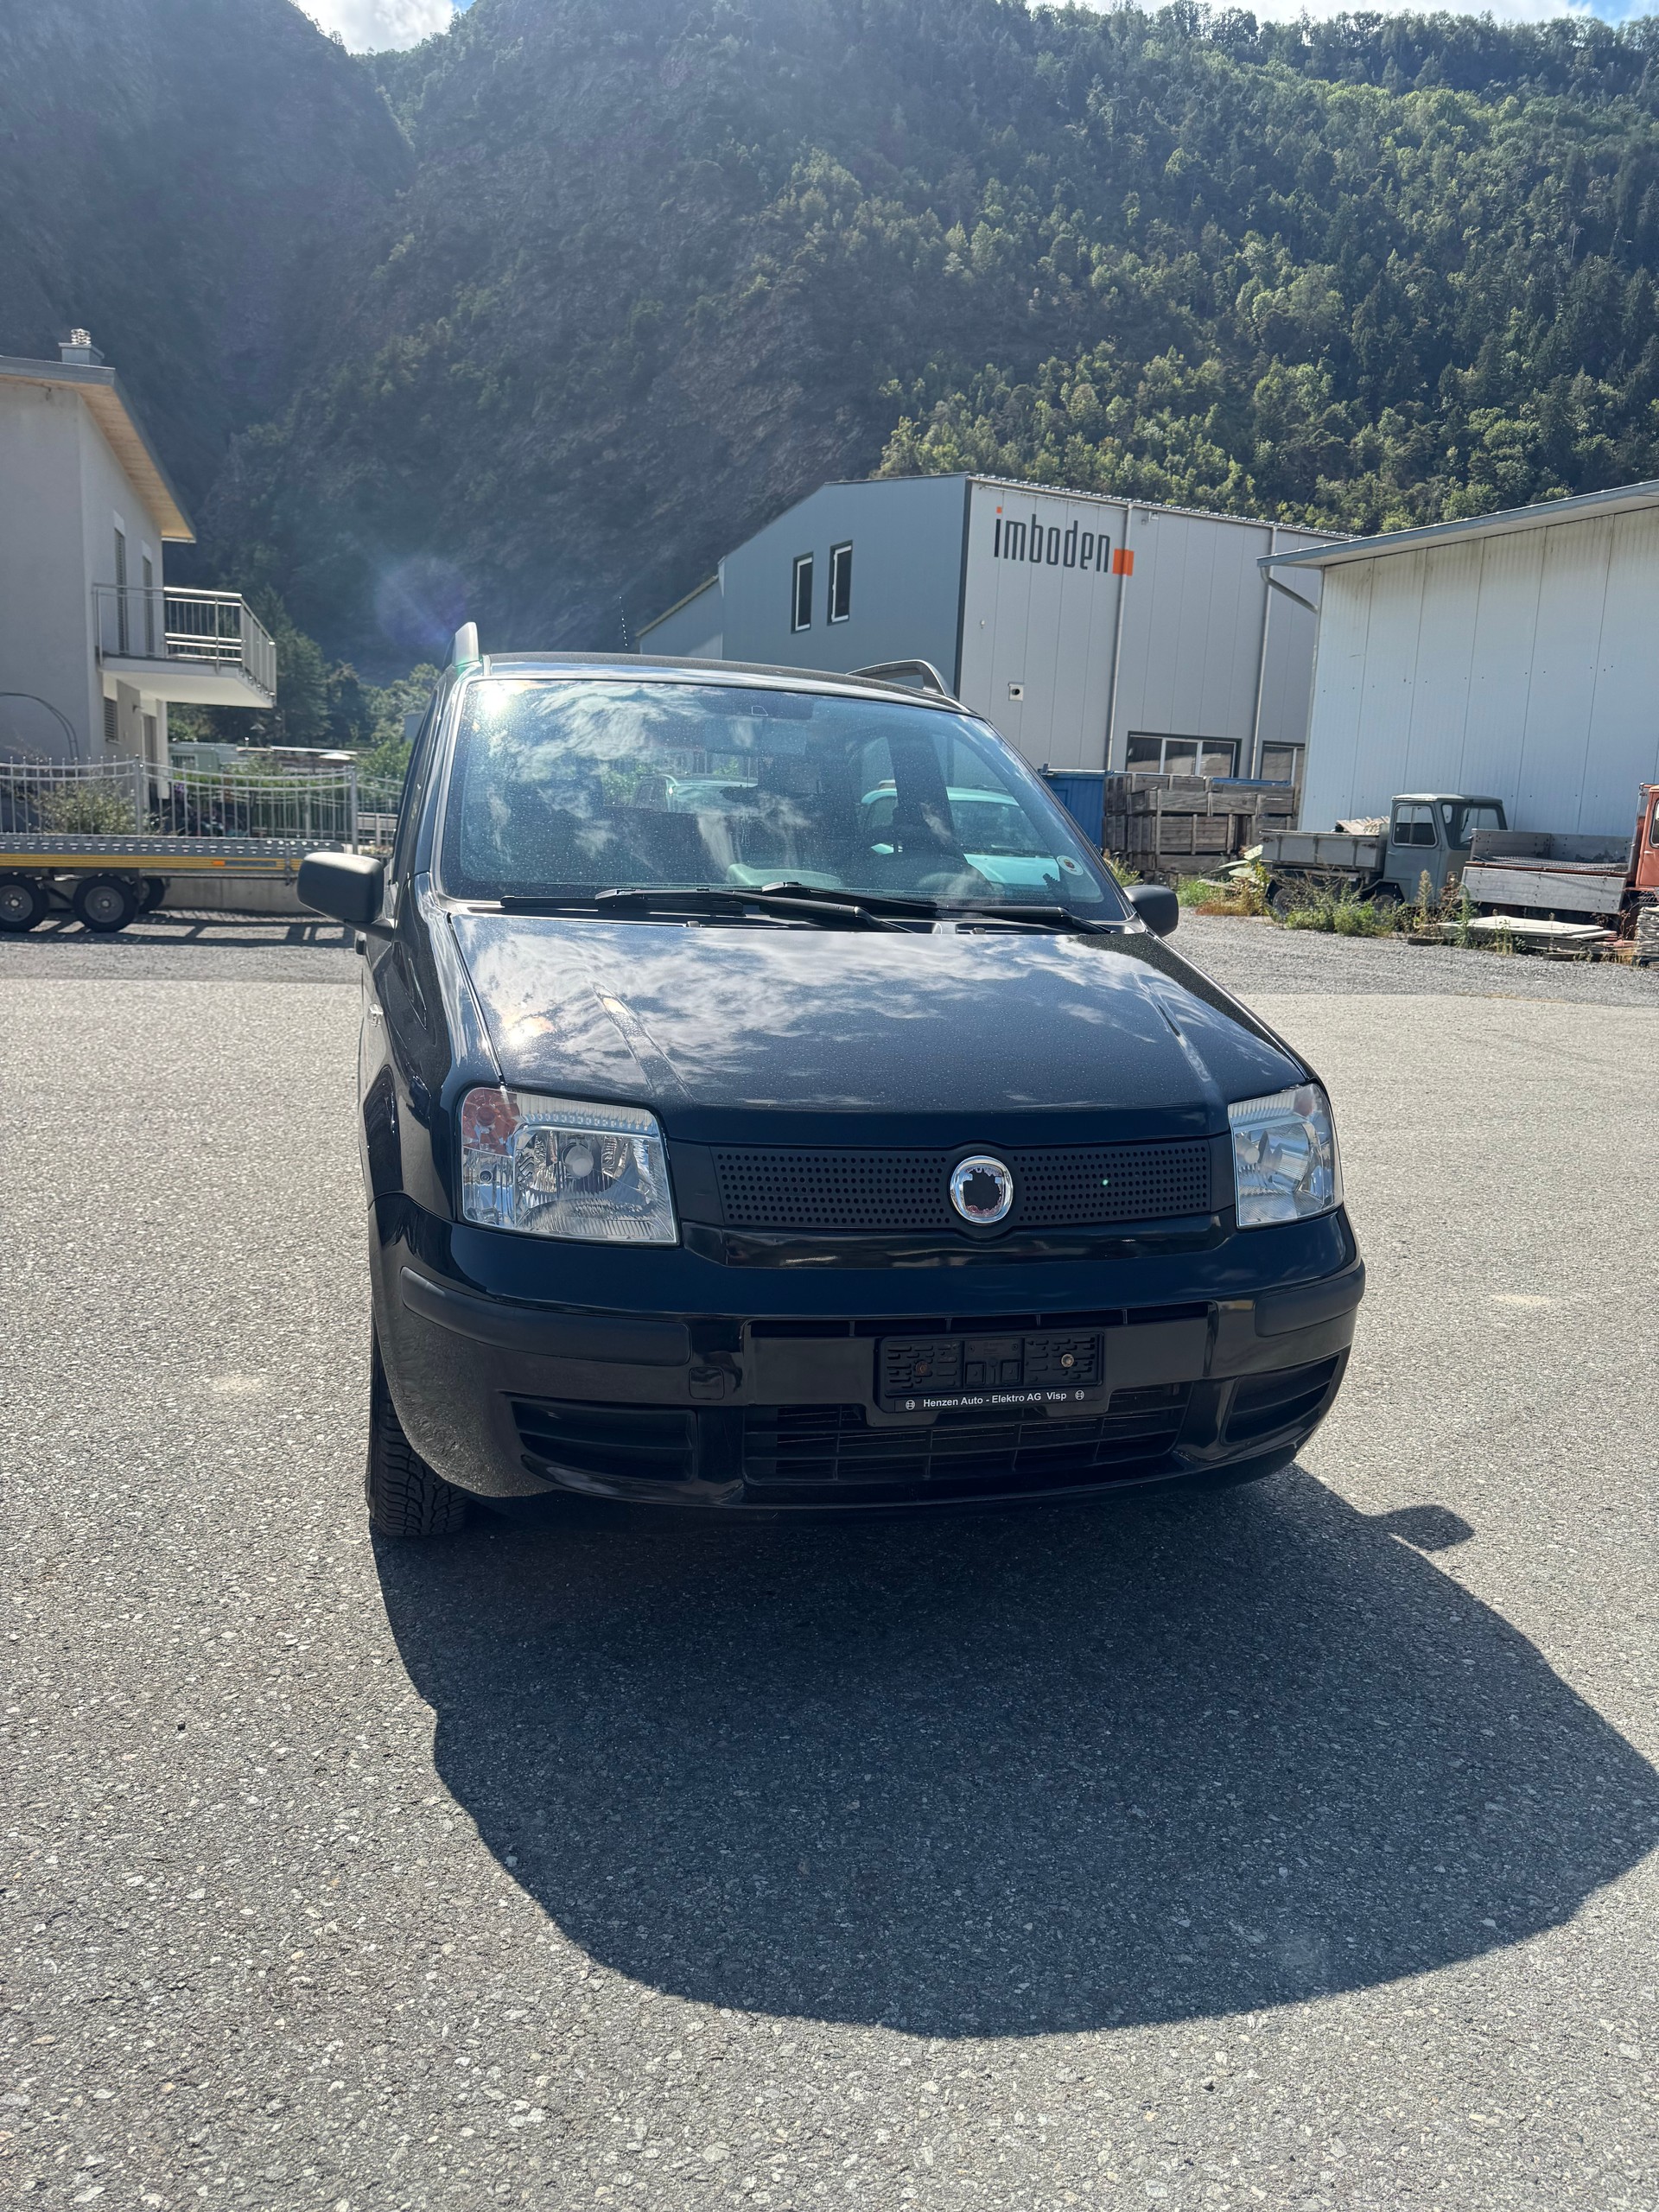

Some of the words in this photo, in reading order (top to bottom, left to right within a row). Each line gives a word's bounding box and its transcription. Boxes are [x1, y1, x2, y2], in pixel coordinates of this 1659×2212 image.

[994, 505, 1110, 573] imboden
[923, 1399, 958, 1408] Henzen
[961, 1396, 983, 1405] Auto
[991, 1394, 1025, 1403] Elektro
[1027, 1392, 1041, 1402] AG
[1046, 1391, 1067, 1402] Visp
